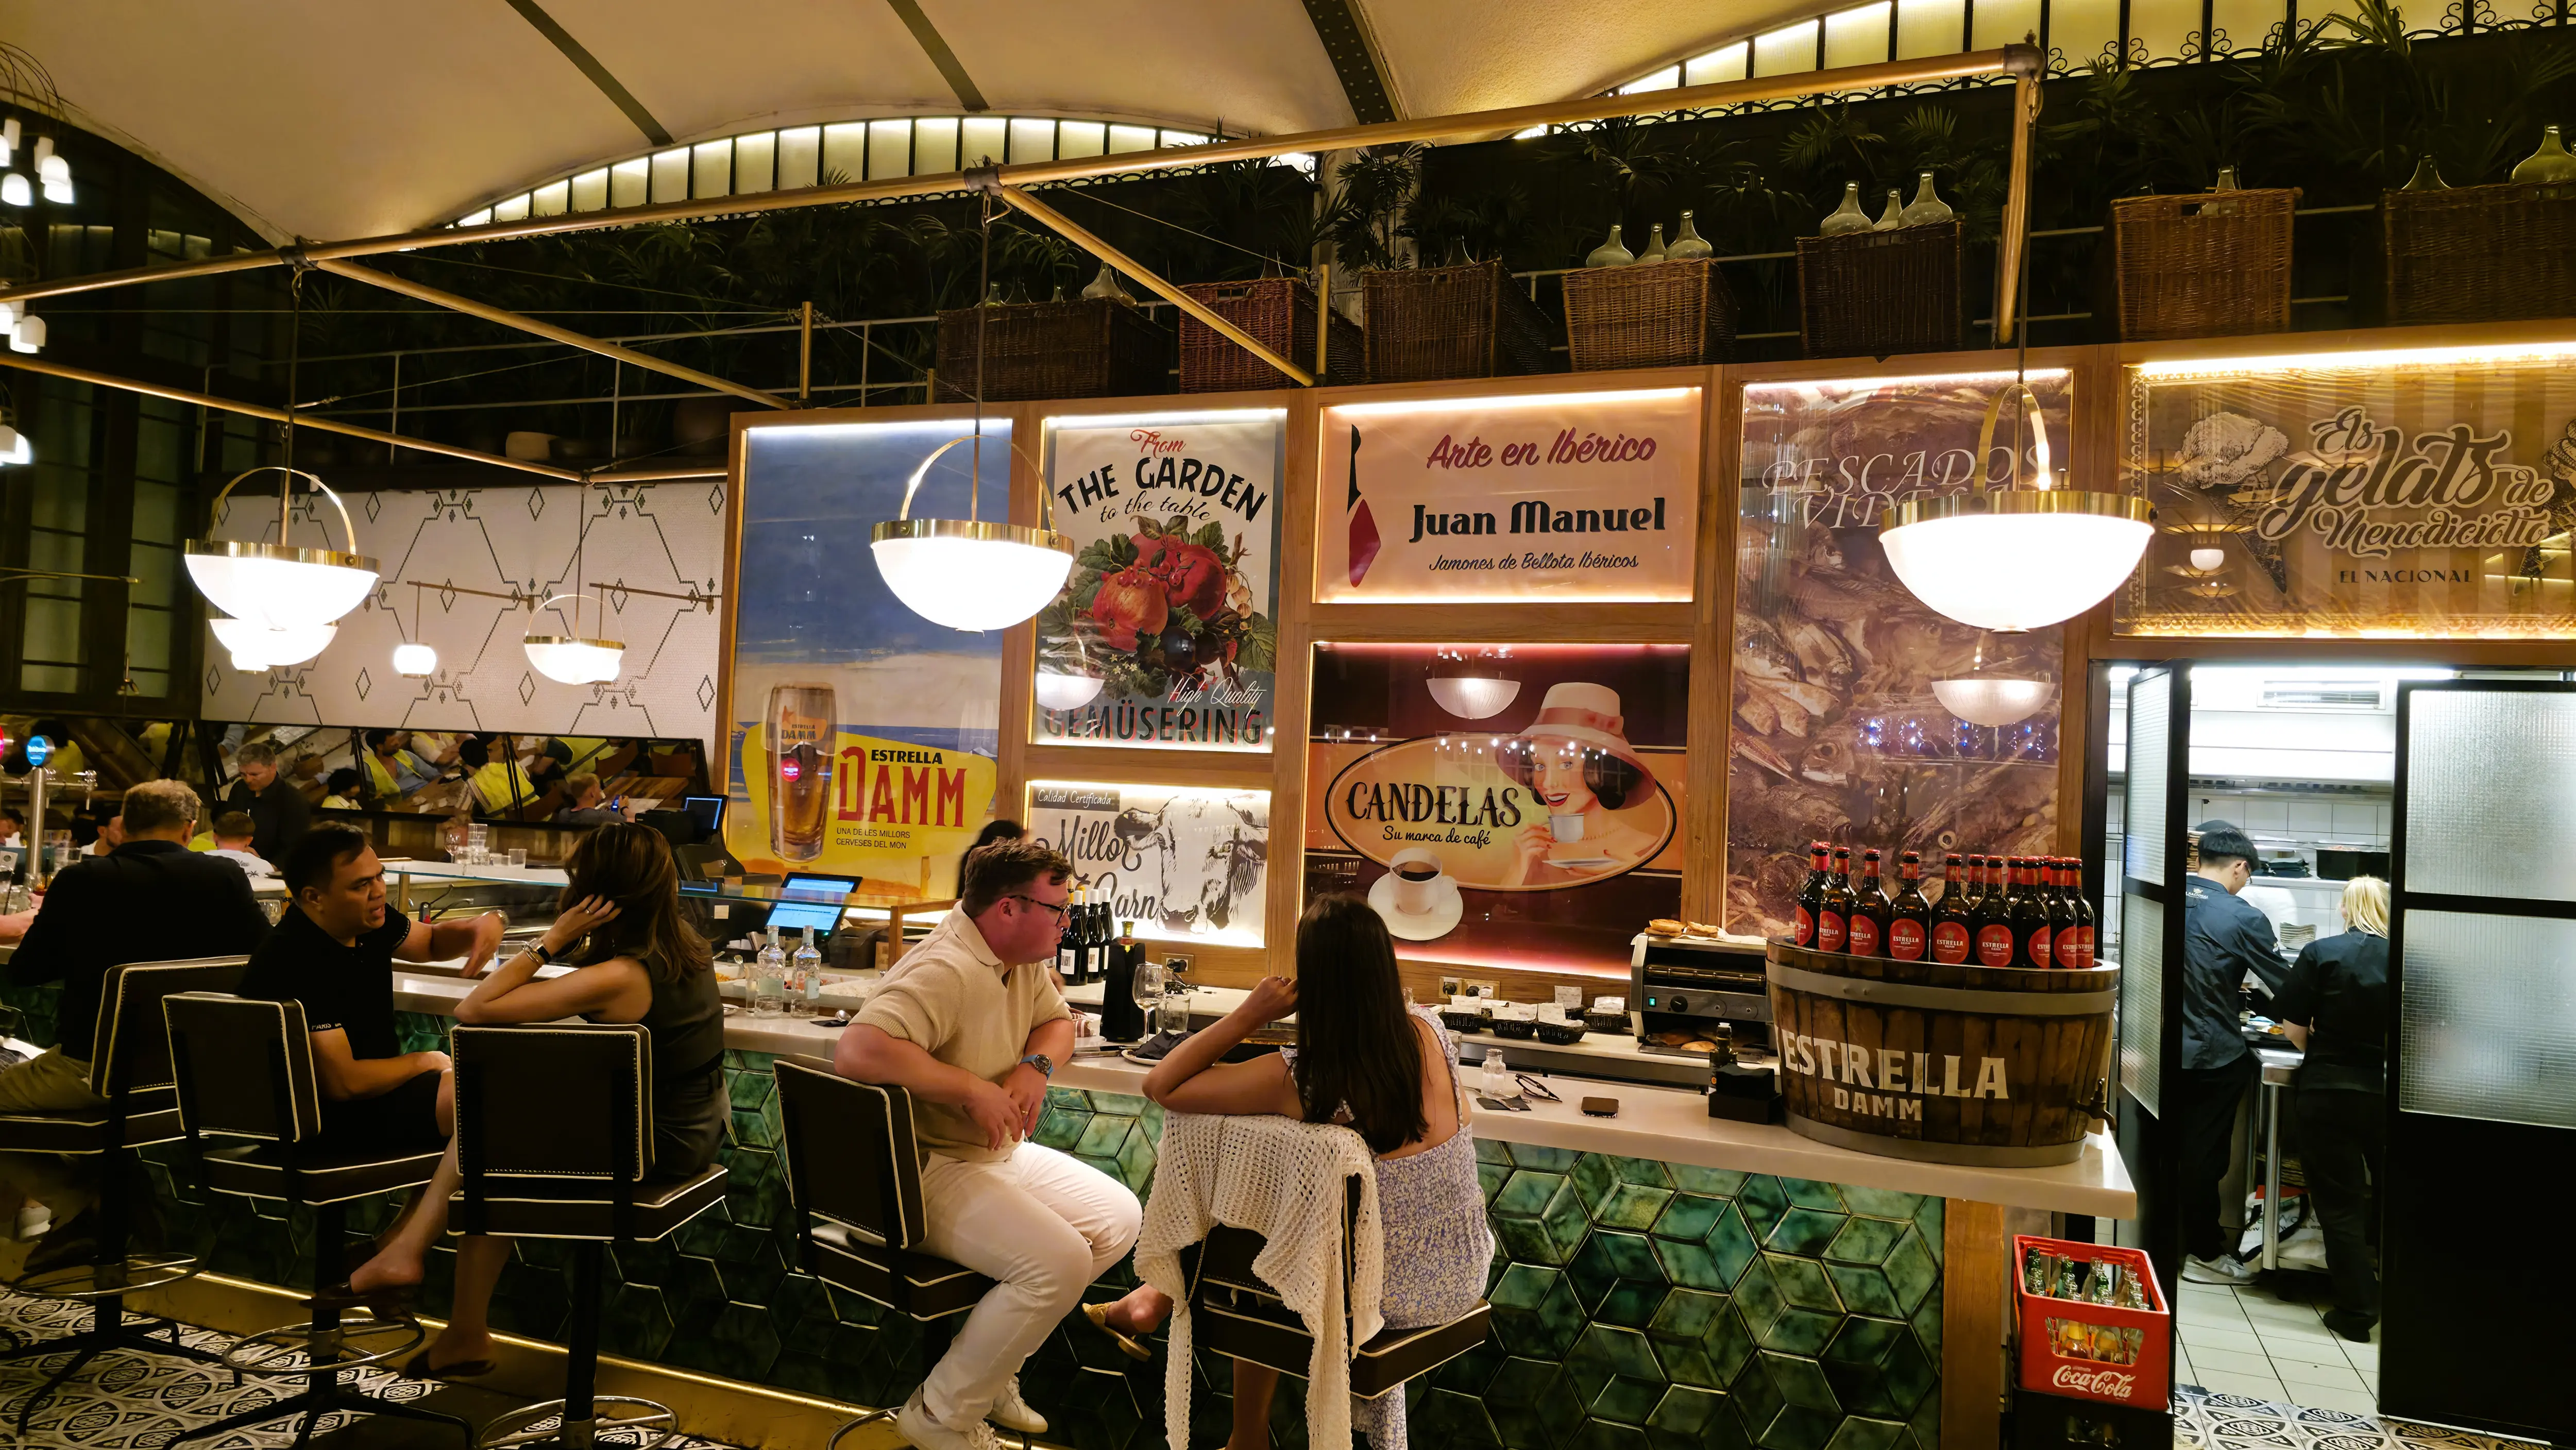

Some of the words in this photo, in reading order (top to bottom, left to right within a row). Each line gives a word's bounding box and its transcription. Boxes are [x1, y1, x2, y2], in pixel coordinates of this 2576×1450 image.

[1130, 429, 1186, 459] From
[1427, 434, 1493, 469] Arte
[1501, 443, 1540, 466] en
[1547, 427, 1656, 464] Ibérico
[1057, 464, 1119, 514] THE
[1136, 457, 1267, 522] GARDEN
[2259, 424, 2510, 539] gelats
[2504, 465, 2553, 506] de
[1100, 505, 1118, 522] to
[1125, 491, 1155, 513] the
[1160, 496, 1211, 520] table
[1409, 504, 1497, 543] Juan
[1510, 497, 1665, 533] Manuel
[1430, 554, 1495, 570] Jamones
[1498, 553, 1517, 569] de
[1521, 552, 1575, 569] Bellota
[1579, 551, 1639, 568] Ibéricos
[2340, 570, 2359, 583] EL
[2367, 570, 2472, 583] NACIONAL
[1167, 678, 1202, 716] High
[1211, 679, 1267, 718] Quality
[782, 730, 816, 739] DAMM
[1045, 700, 1263, 747] GEMÜSERING
[871, 750, 943, 764] ESTRELLA
[837, 746, 968, 828] DAMM
[1038, 789, 1068, 802] Calidad
[1071, 790, 1111, 808] Certificada
[1346, 782, 1521, 828] CANDELAS
[837, 838, 872, 847] CERVESES
[879, 830, 910, 838] MILLORS
[1383, 825, 1402, 840] Su
[1405, 832, 1443, 842] marca
[1446, 828, 1462, 844] de
[1464, 830, 1491, 849] café
[1782, 1028, 2009, 1099] ESTRELLA
[1834, 1087, 1922, 1121] DAMM
[2053, 1365, 2136, 1398] Coca-Cola
